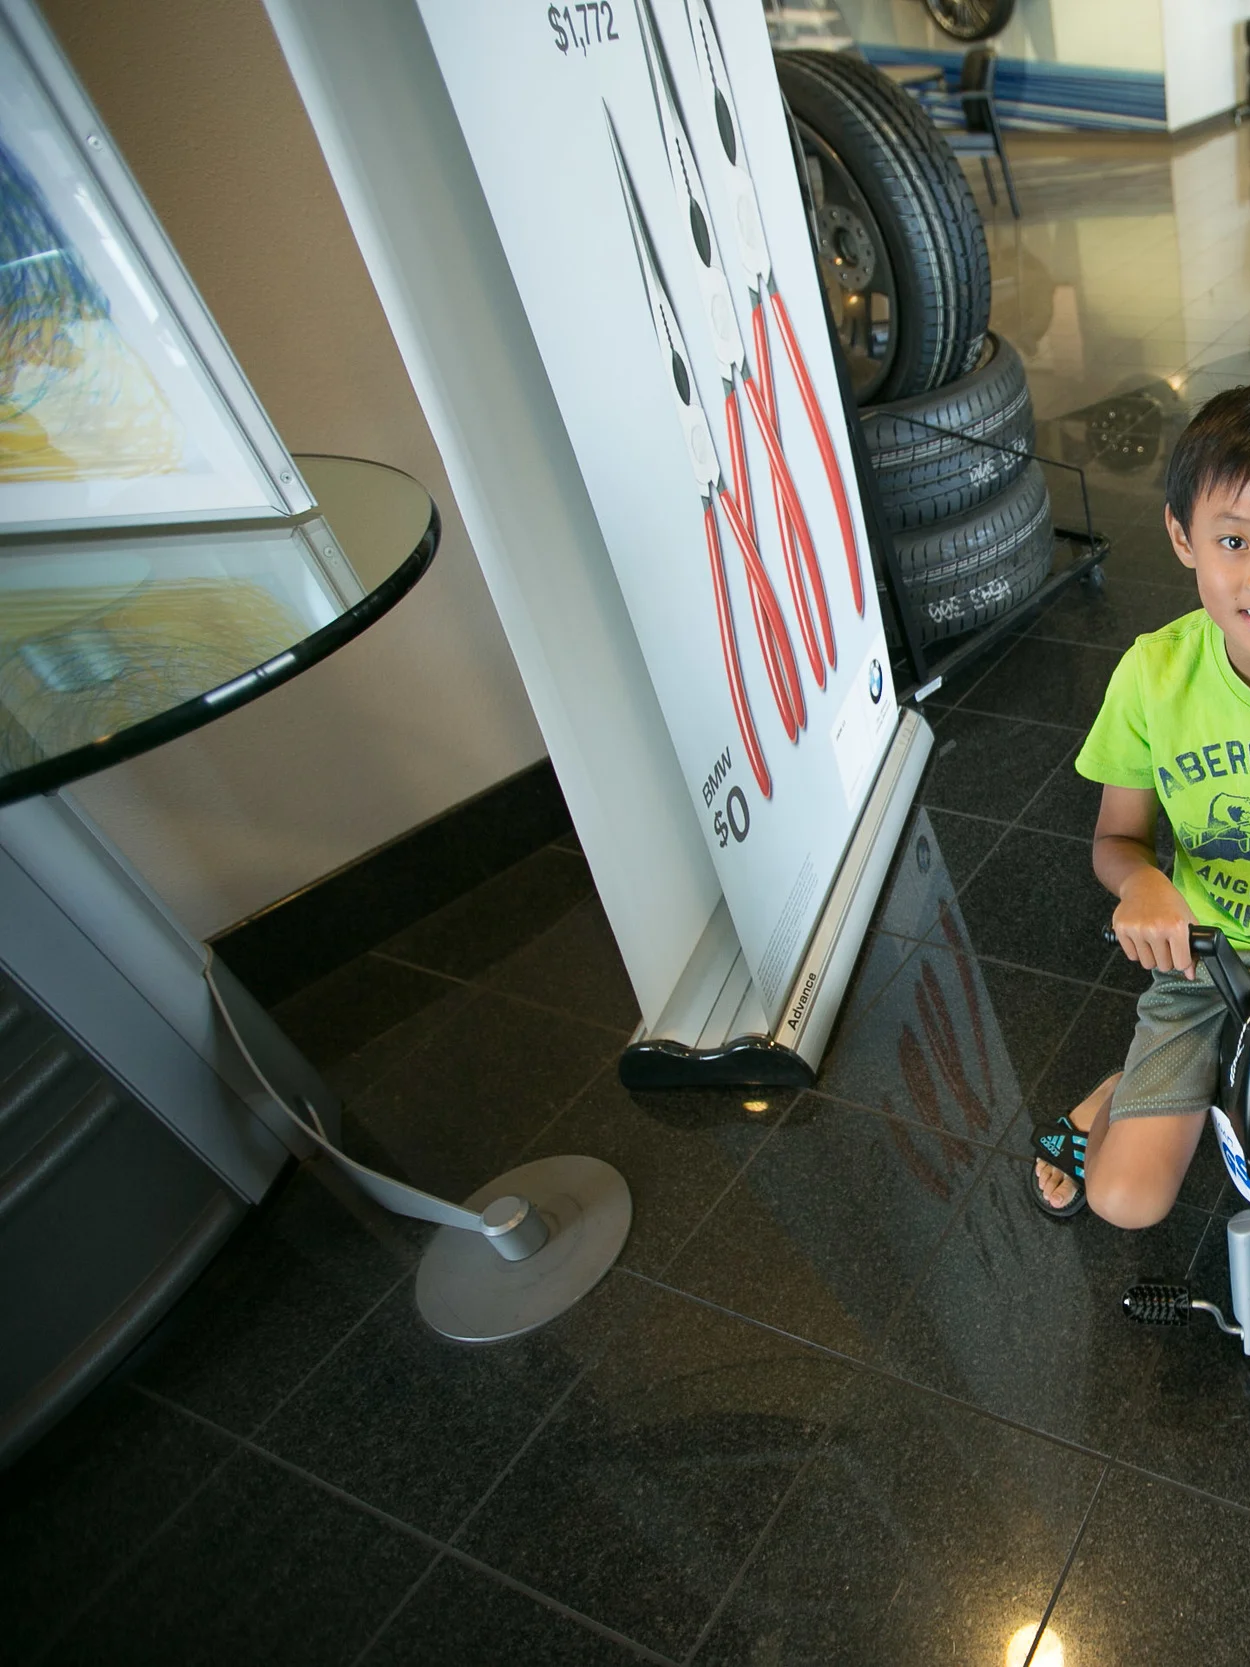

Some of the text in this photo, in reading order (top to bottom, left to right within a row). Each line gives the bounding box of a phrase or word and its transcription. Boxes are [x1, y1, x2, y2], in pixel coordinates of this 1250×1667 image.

[547, 1, 620, 57] $1,772
[702, 745, 732, 809] BMW
[714, 785, 750, 848] $0
[787, 972, 817, 1031] Advance
